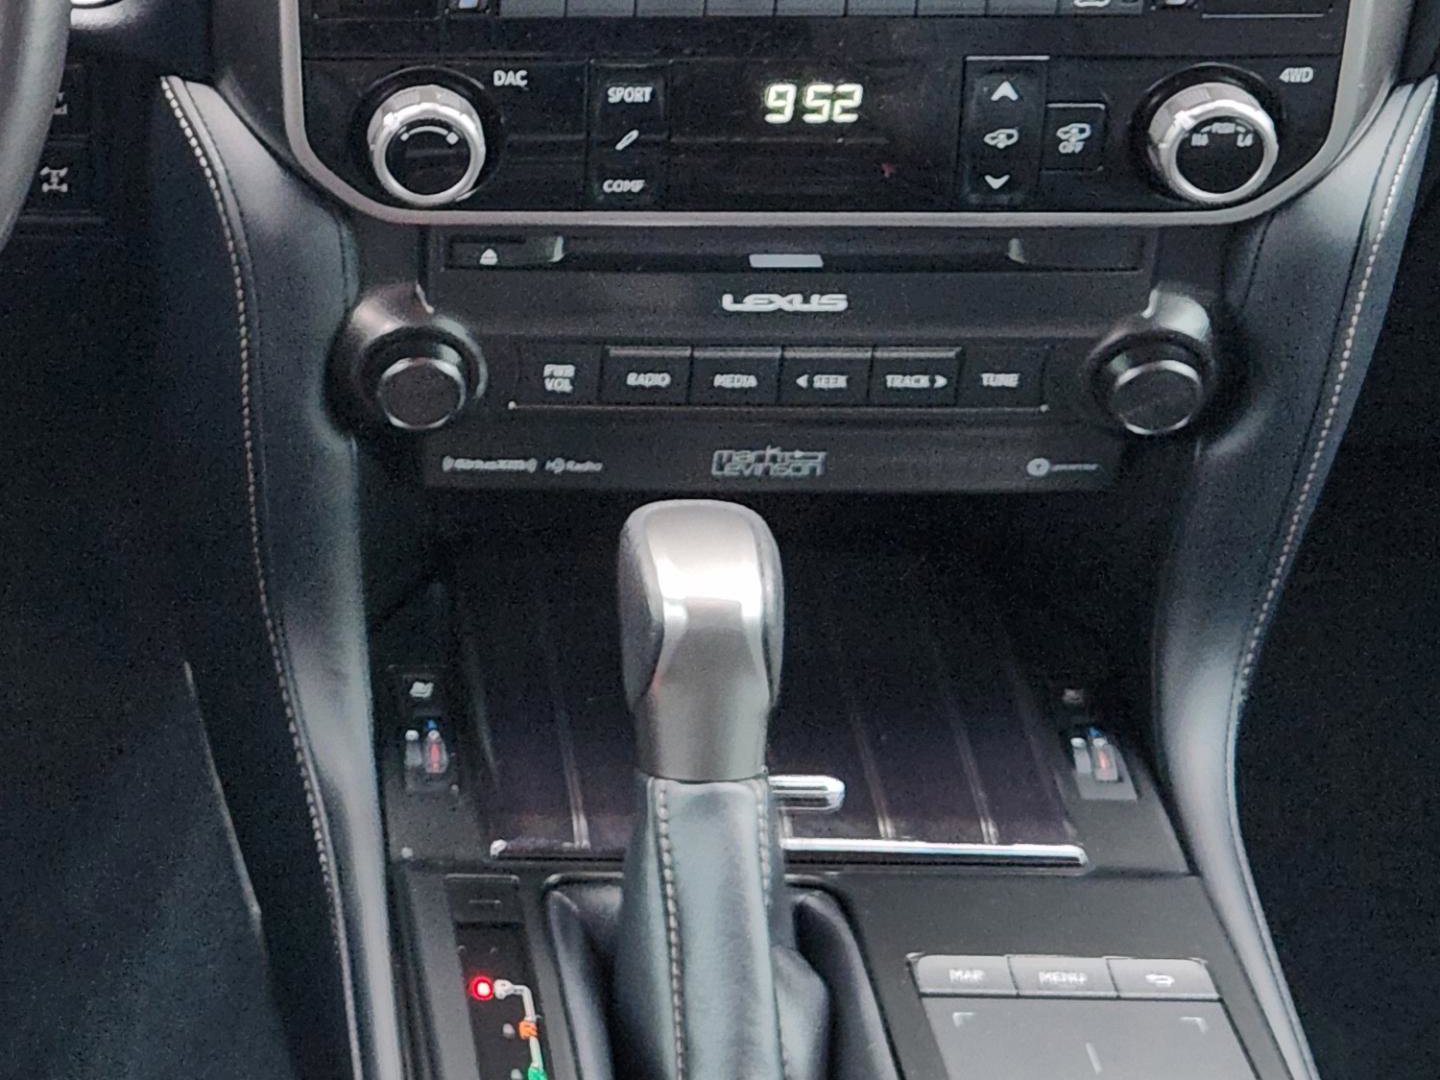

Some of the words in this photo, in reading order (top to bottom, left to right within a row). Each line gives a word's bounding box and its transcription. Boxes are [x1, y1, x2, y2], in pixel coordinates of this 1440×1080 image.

[493, 69, 528, 87] DAC
[1279, 66, 1314, 83] 4WD
[607, 86, 653, 103] SPORT
[722, 293, 849, 312] LEXUS
[626, 372, 672, 387] RADIO
[713, 374, 758, 389] MEDIA
[948, 968, 984, 983] MAP
